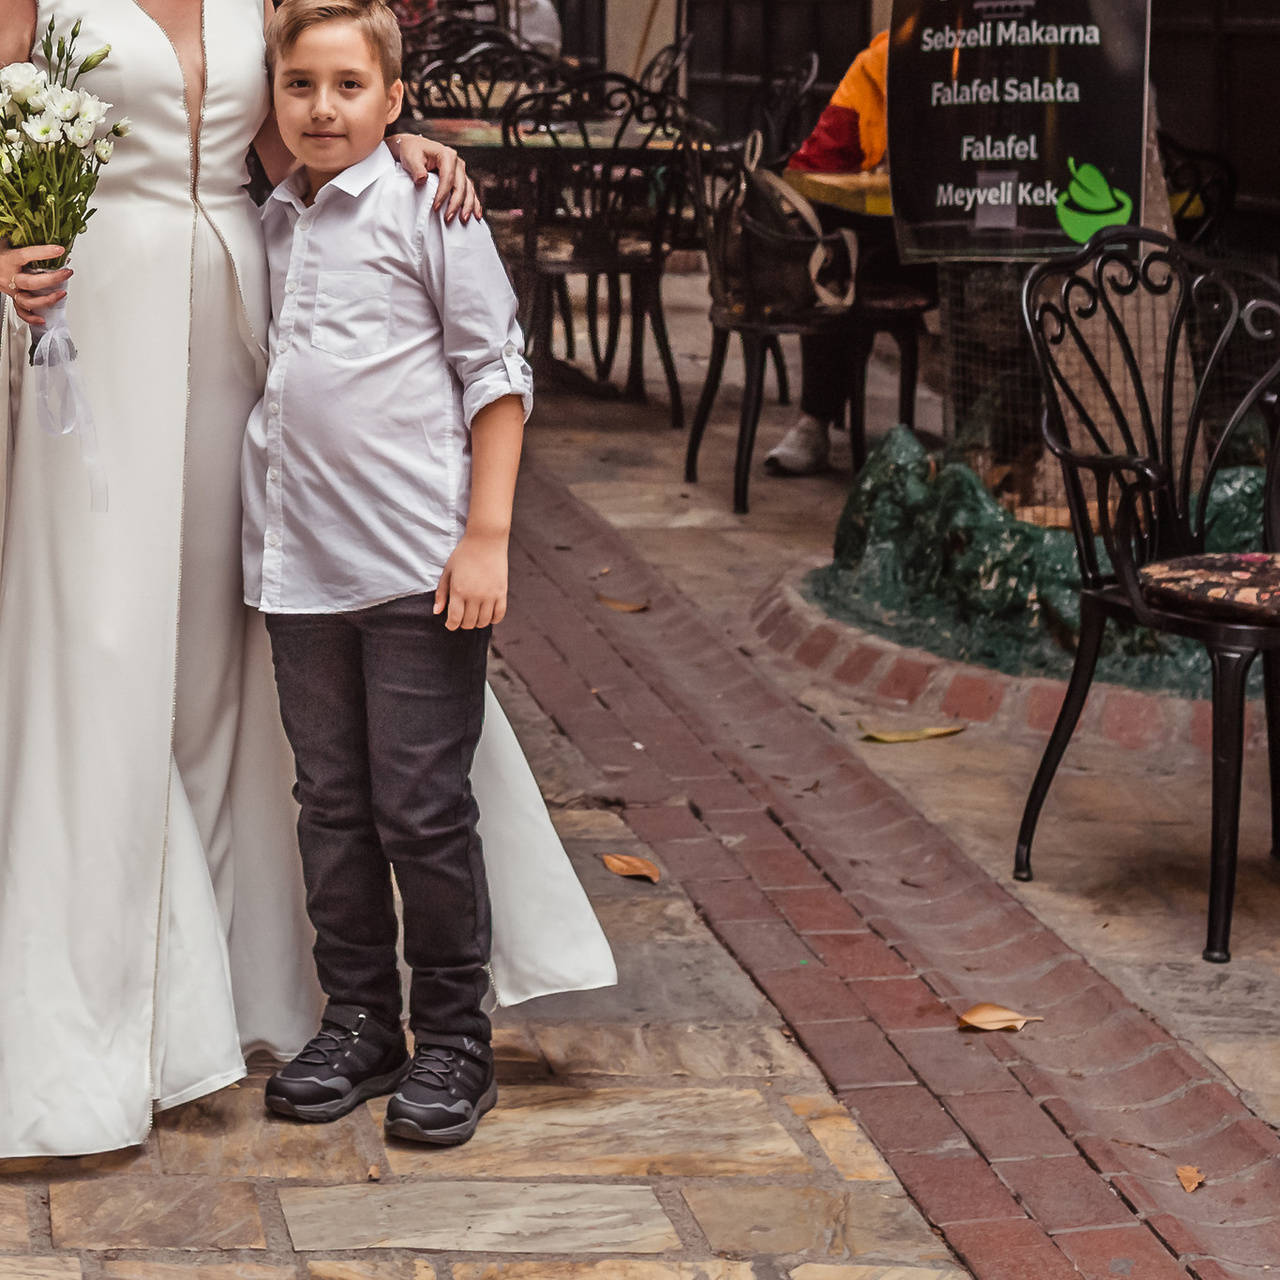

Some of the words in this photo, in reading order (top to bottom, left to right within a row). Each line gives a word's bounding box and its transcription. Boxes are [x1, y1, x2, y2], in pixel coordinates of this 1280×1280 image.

[921, 21, 992, 52] Sebzeli
[996, 20, 1101, 47] Makarna
[931, 78, 1000, 107] Falafel
[1003, 76, 1081, 104] Salata
[960, 134, 1039, 161] Falafel
[936, 181, 1014, 211] Meyveli
[1018, 180, 1059, 207] Kek
